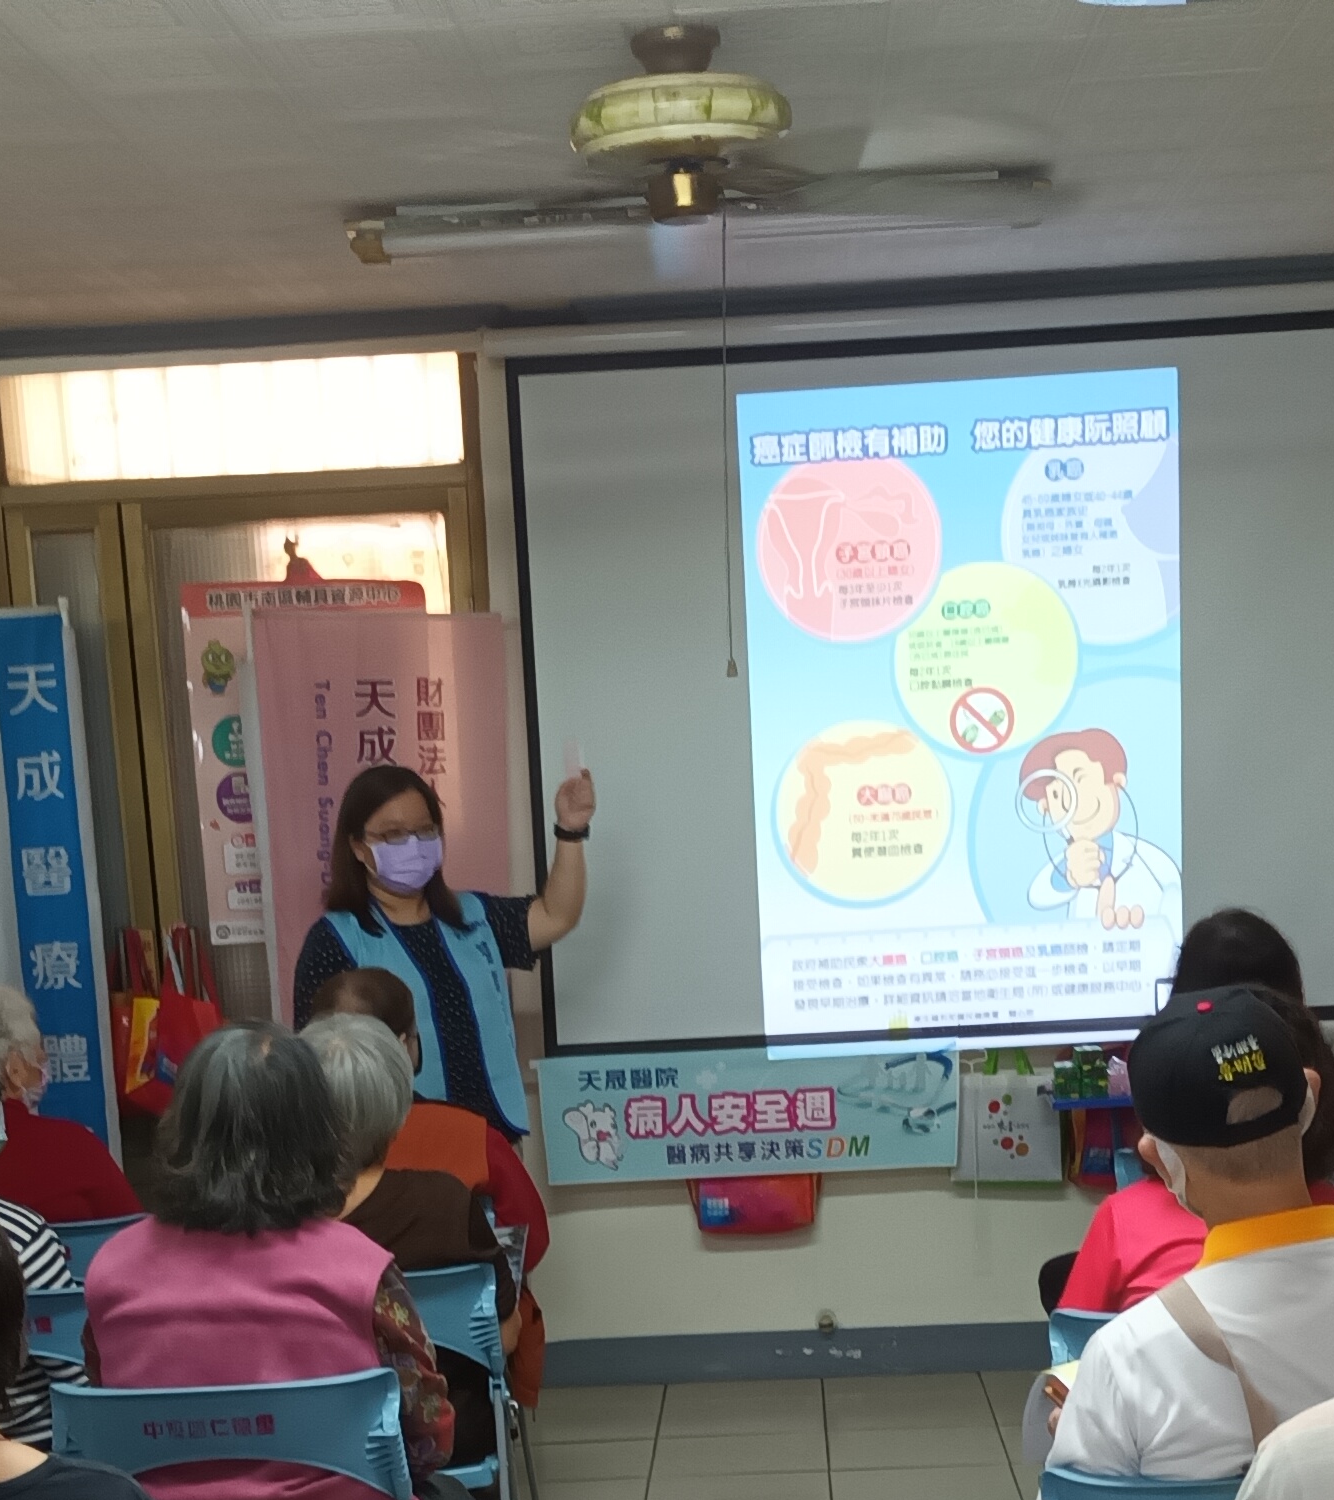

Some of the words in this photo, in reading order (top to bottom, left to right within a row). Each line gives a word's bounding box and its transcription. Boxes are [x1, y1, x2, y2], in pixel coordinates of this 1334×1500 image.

[354, 678, 398, 766] 天成
[578, 1067, 679, 1092] 天晟醫院
[624, 1087, 837, 1140] 病人安全週
